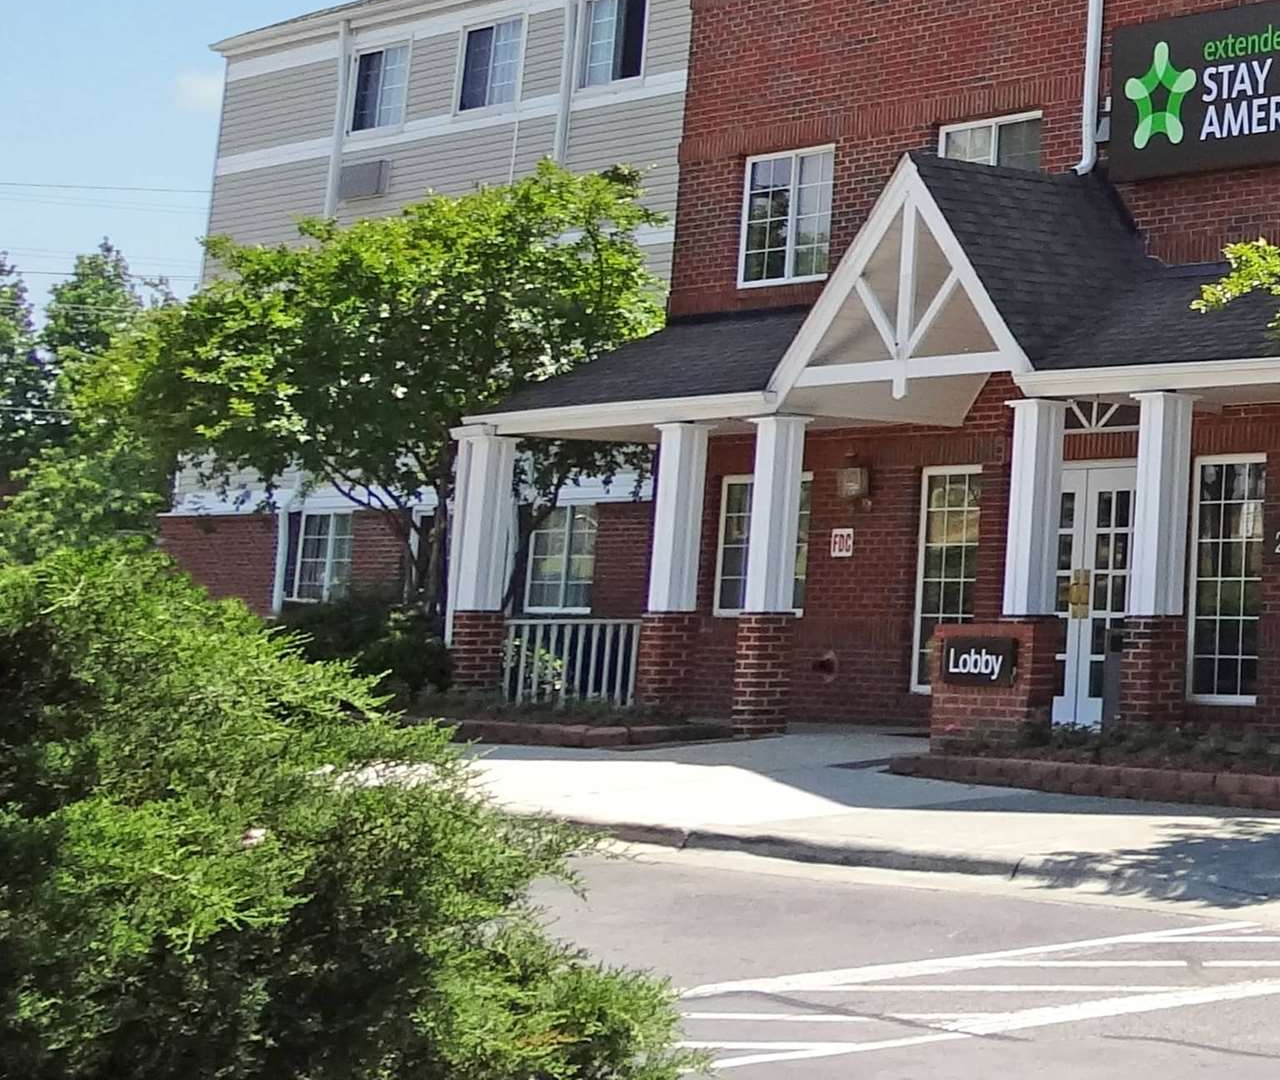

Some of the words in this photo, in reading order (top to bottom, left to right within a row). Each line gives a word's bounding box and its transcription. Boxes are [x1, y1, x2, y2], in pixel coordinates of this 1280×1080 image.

[1202, 58, 1273, 103] STAY
[833, 533, 852, 552] FDC
[948, 647, 1003, 681] Lobby
